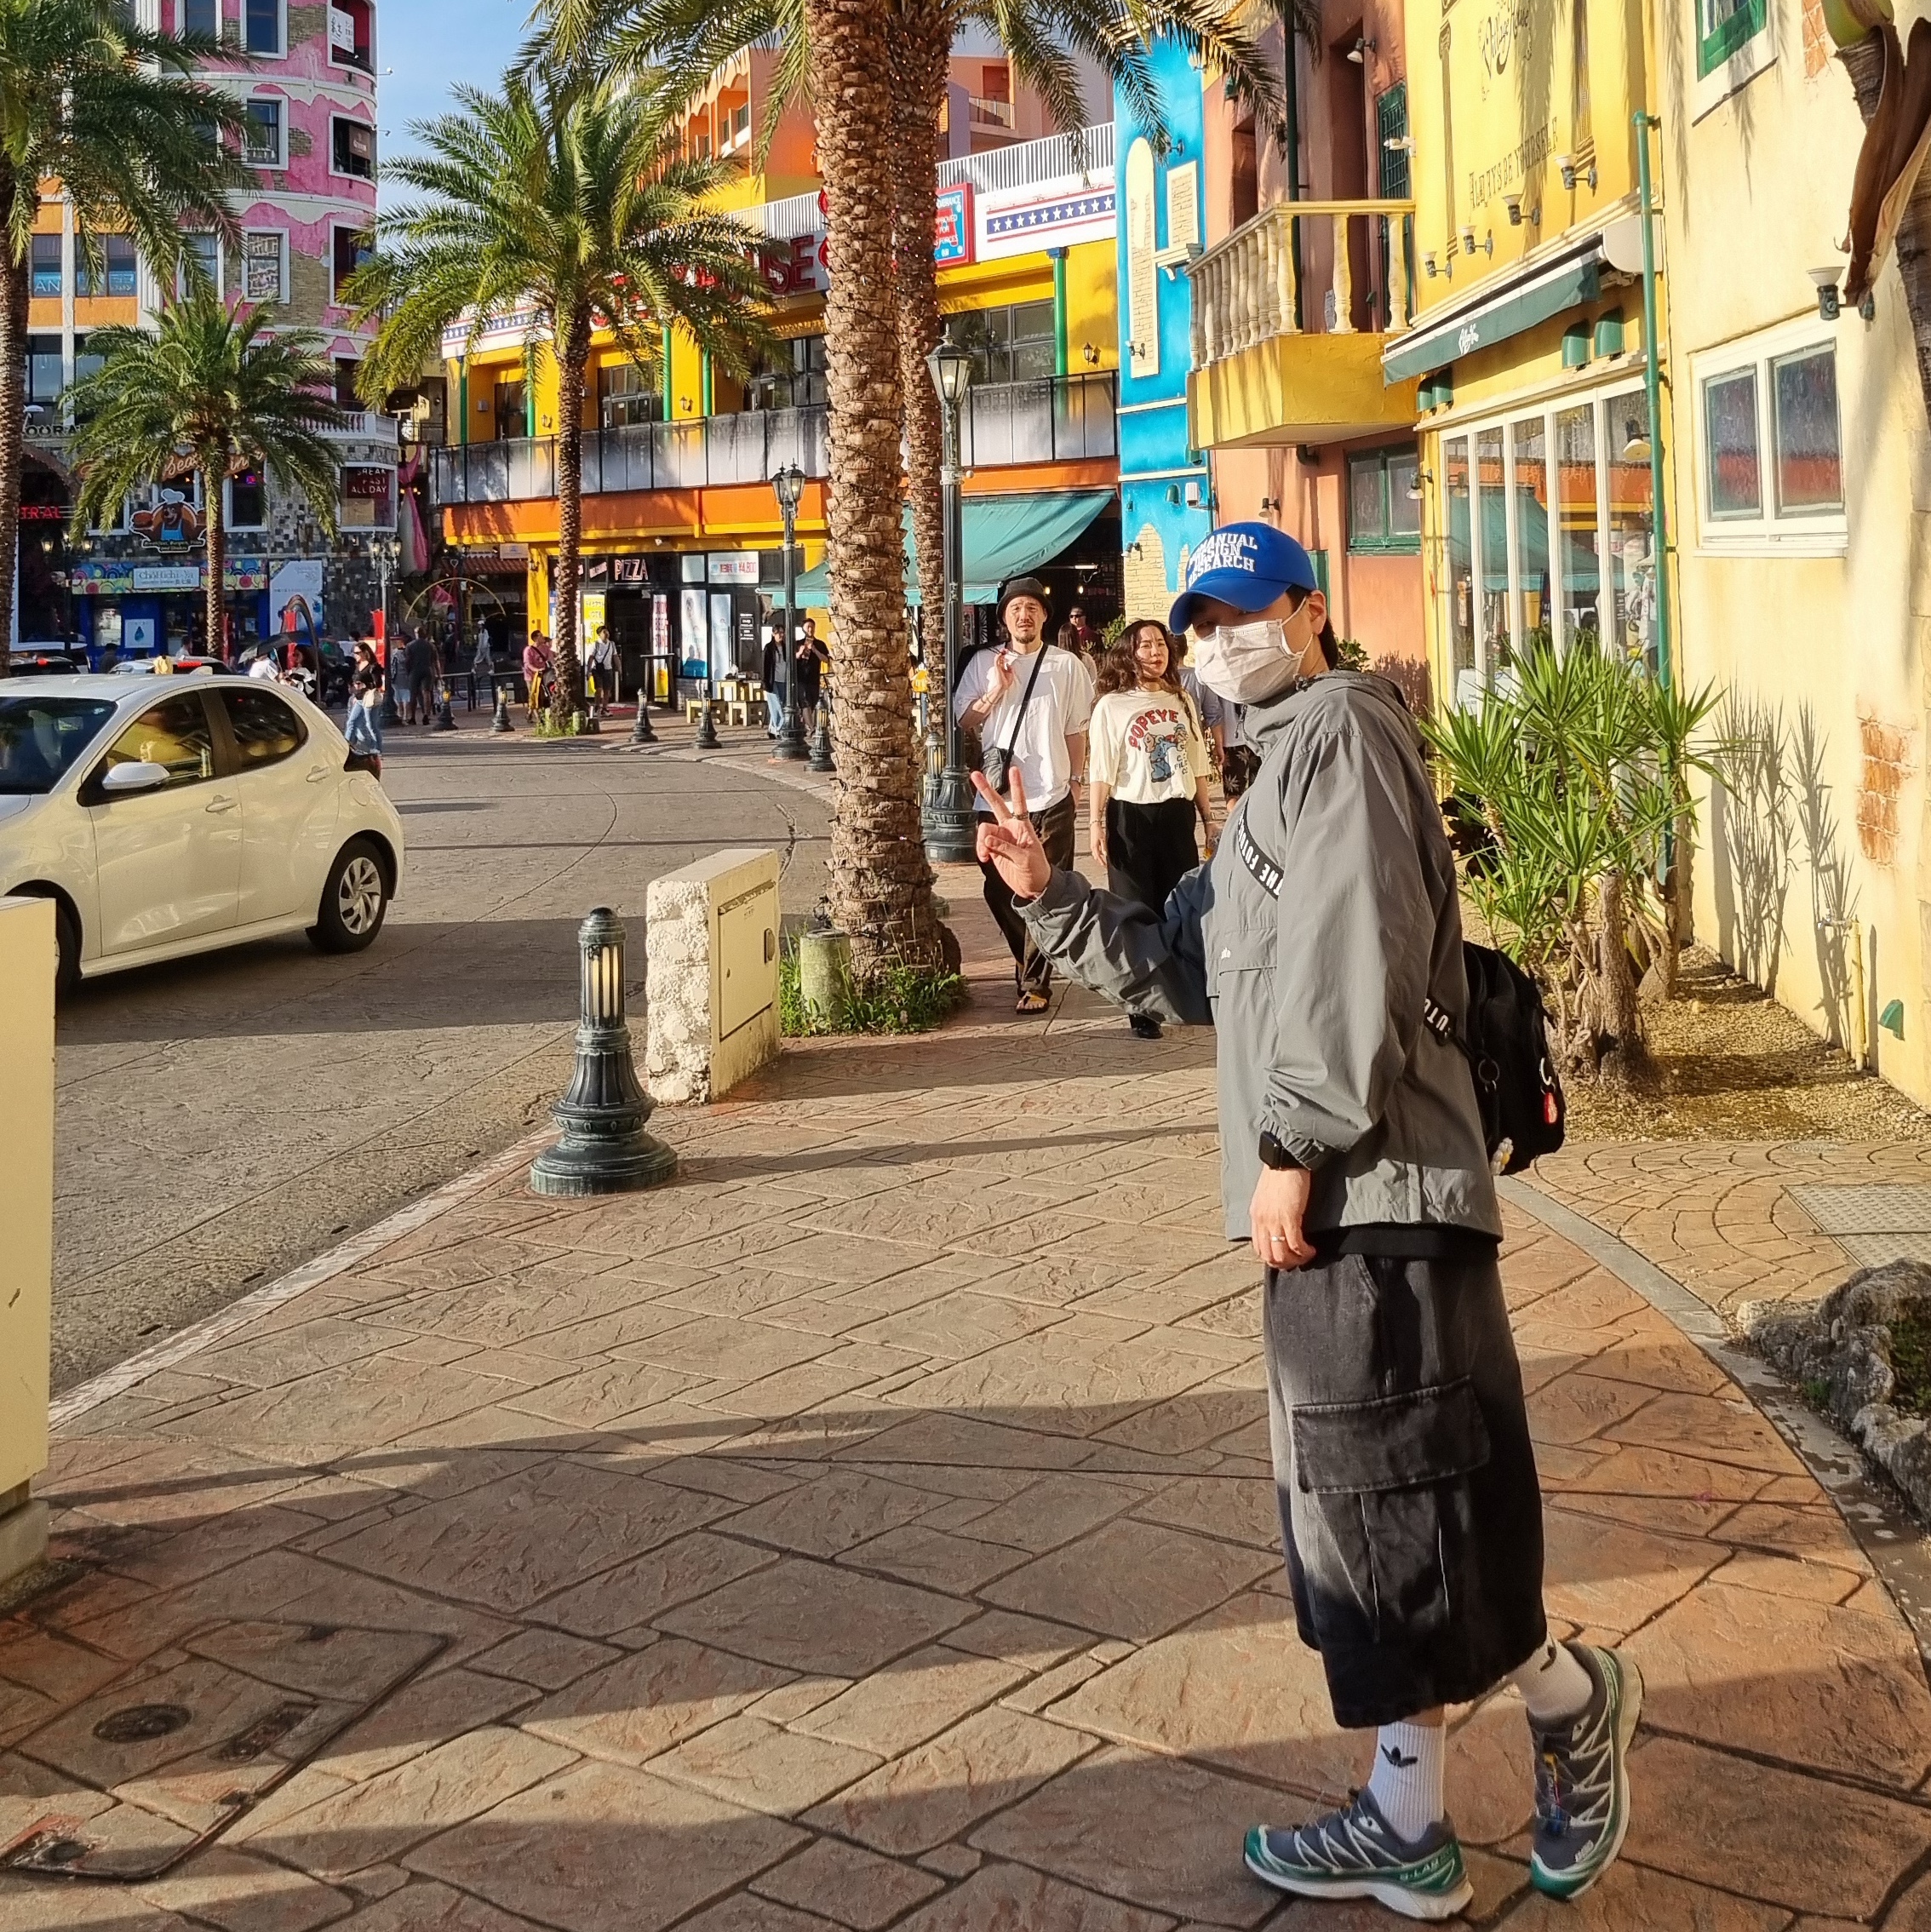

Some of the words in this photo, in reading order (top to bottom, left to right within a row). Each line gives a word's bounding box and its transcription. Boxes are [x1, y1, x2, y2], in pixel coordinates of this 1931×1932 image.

[369, 485, 387, 494] DAY
[614, 558, 649, 581] PIZZA
[1189, 554, 1255, 589] RESEARCH
[1127, 708, 1179, 748] POPEYE
